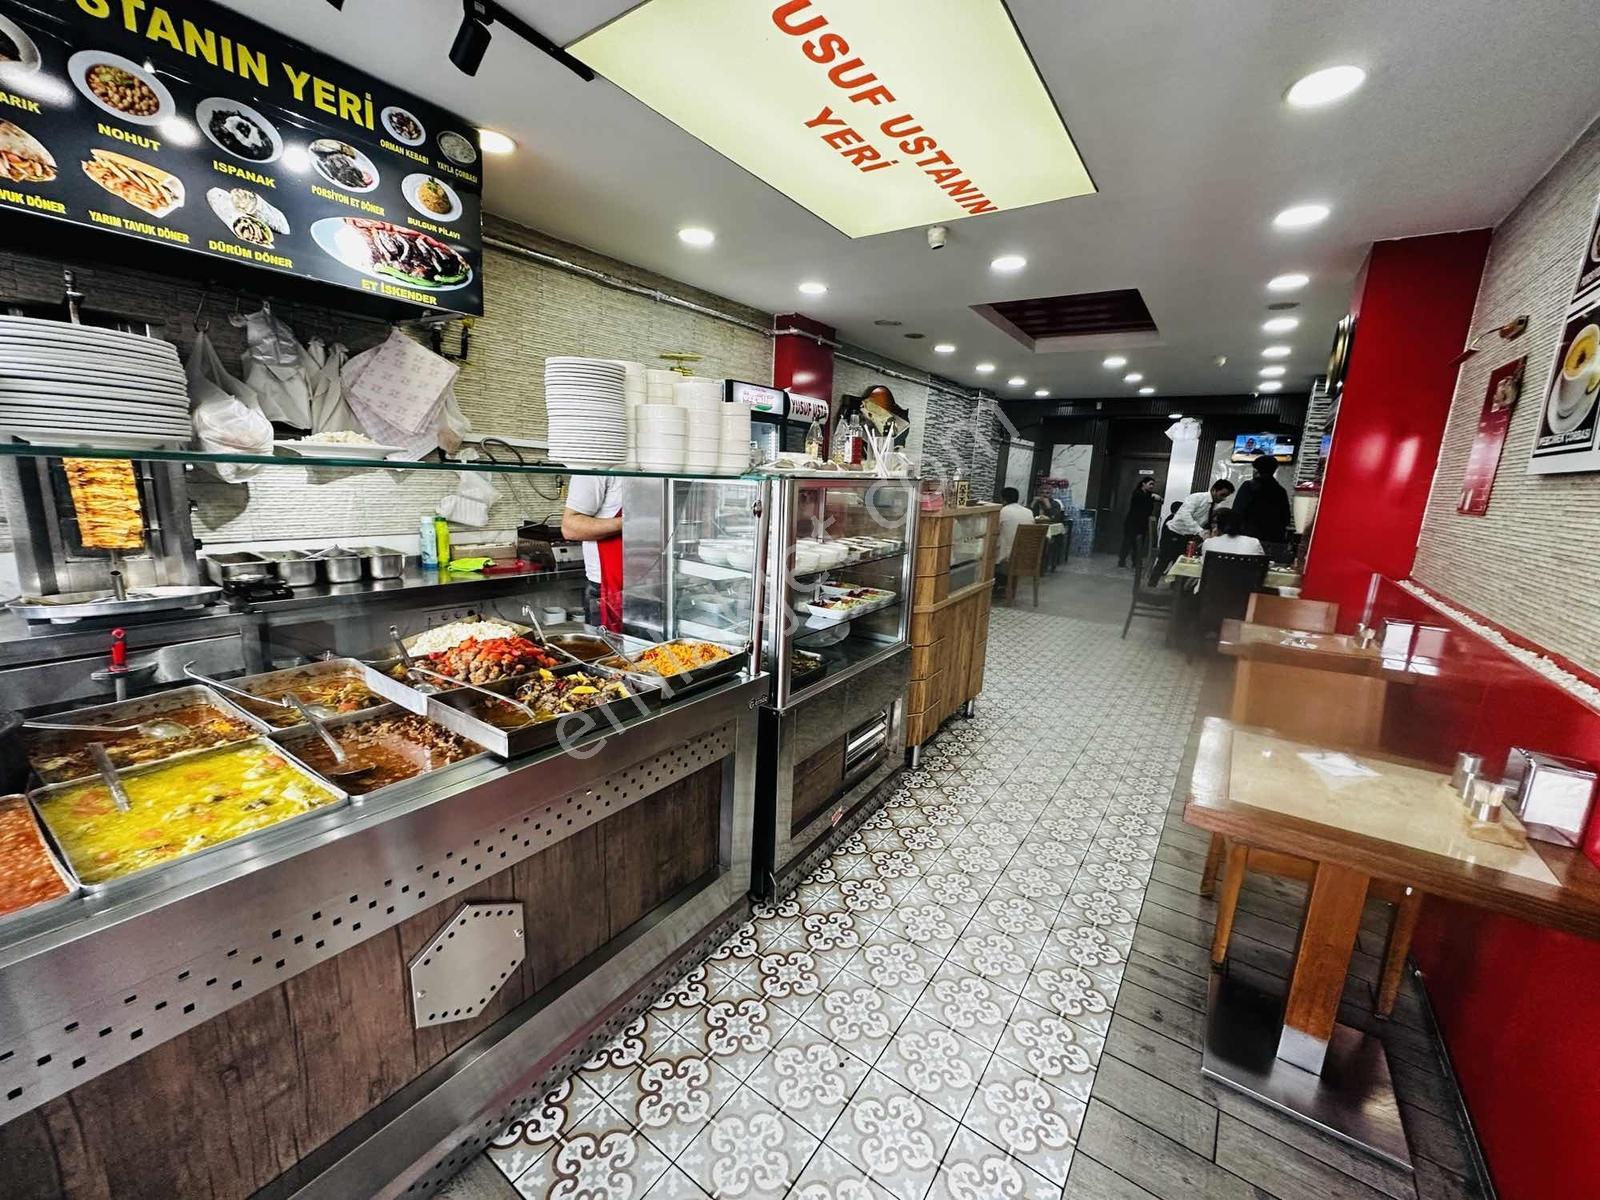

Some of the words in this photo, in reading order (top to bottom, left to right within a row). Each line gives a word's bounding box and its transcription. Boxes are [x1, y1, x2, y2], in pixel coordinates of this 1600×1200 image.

[281, 61, 375, 131] YERİ
[97, 122, 161, 152] NOHUT
[380, 138, 405, 155] ORMAN
[804, 106, 899, 173] YERİ
[213, 160, 277, 188] ISPANAK
[880, 114, 998, 214] USTANIN
[26, 195, 68, 214] DÖNER
[311, 185, 350, 204] PORSİYON
[350, 197, 360, 208] ET
[360, 201, 385, 216] DÖNER
[89, 210, 122, 227] YARIM
[123, 219, 156, 235] TAVUK
[158, 227, 190, 244] DÖNER
[407, 217, 438, 233] BULGUR
[438, 227, 461, 241] PİLAVI
[208, 240, 253, 259] DÜRÜM
[254, 250, 293, 269] DÖNER
[361, 279, 378, 290] ET
[380, 279, 438, 305] İSKENDER
[791, 399, 811, 416] YUSUF
